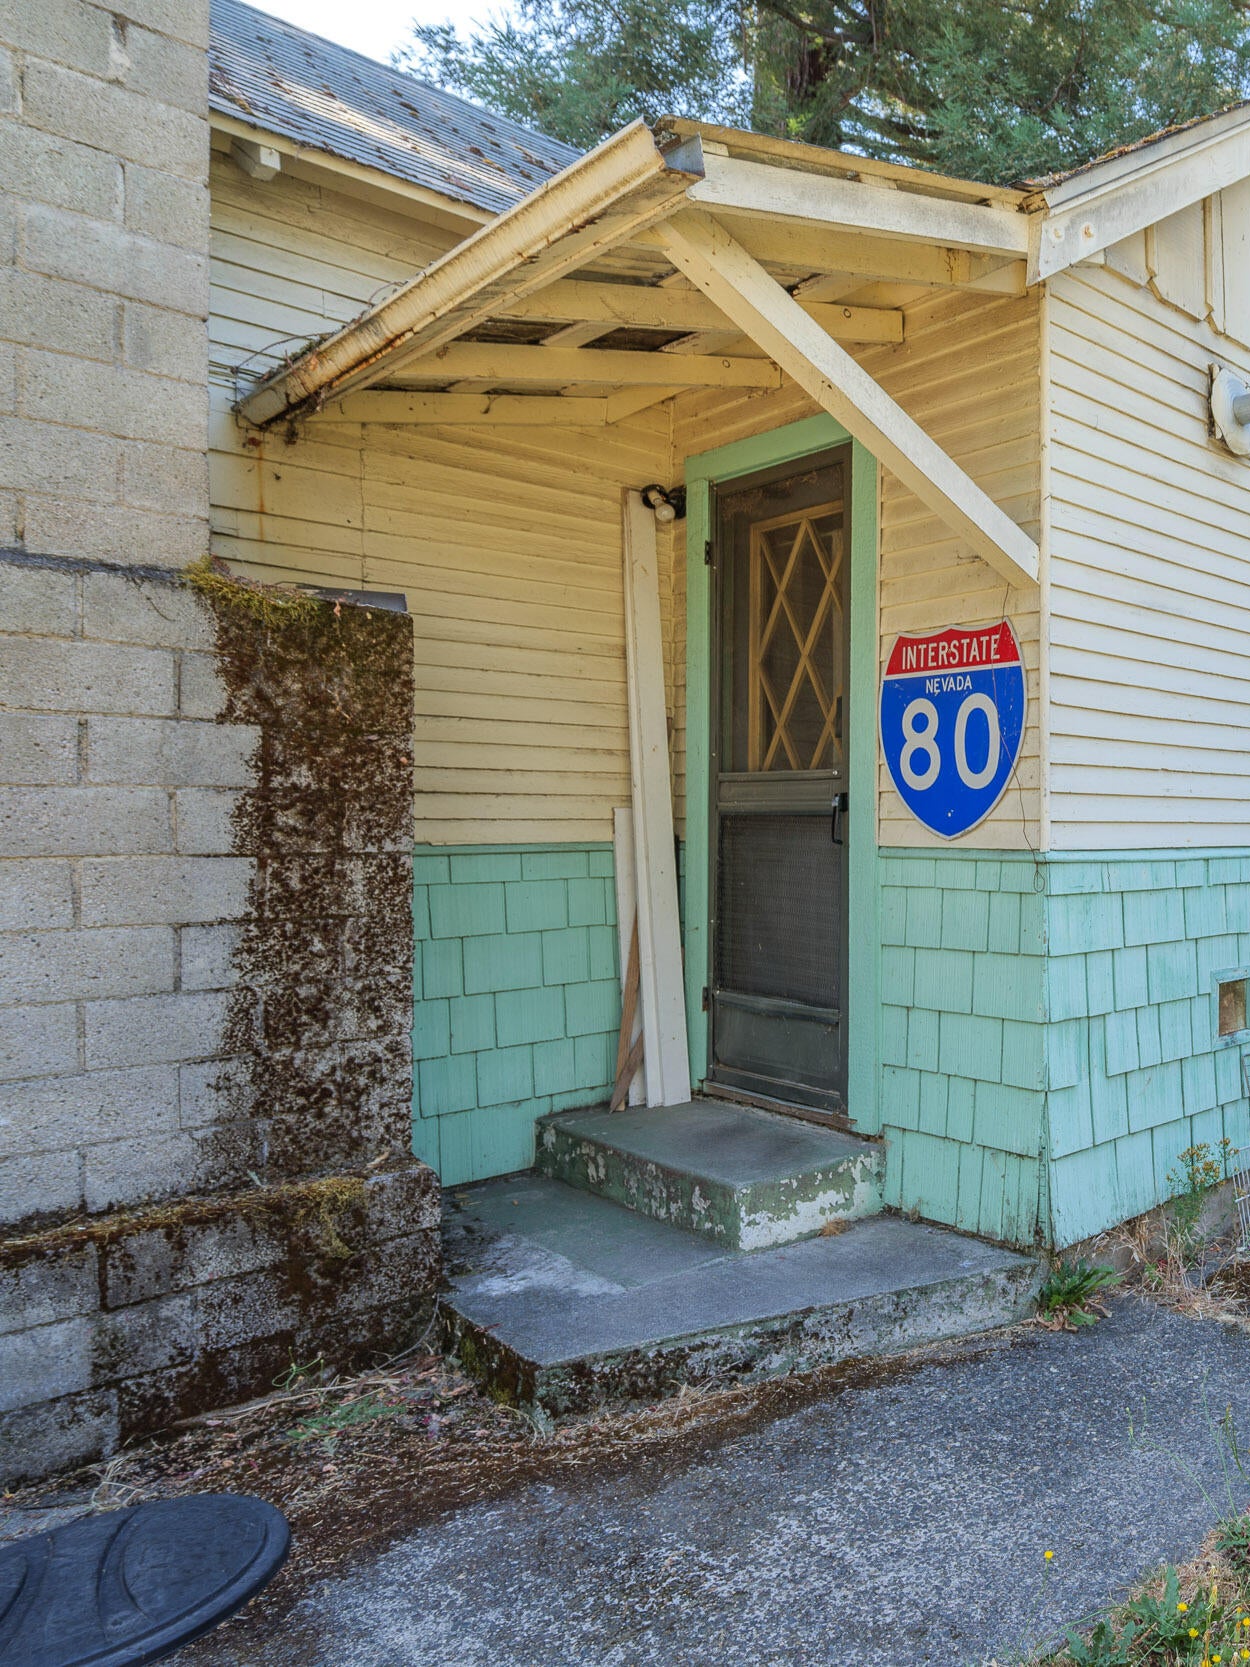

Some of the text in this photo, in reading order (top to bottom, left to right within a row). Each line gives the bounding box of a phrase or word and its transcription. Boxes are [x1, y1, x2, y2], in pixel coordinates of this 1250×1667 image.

[902, 634, 1000, 669] INTERSTATE
[925, 675, 972, 693] NEVADA
[900, 693, 1000, 790] 80
